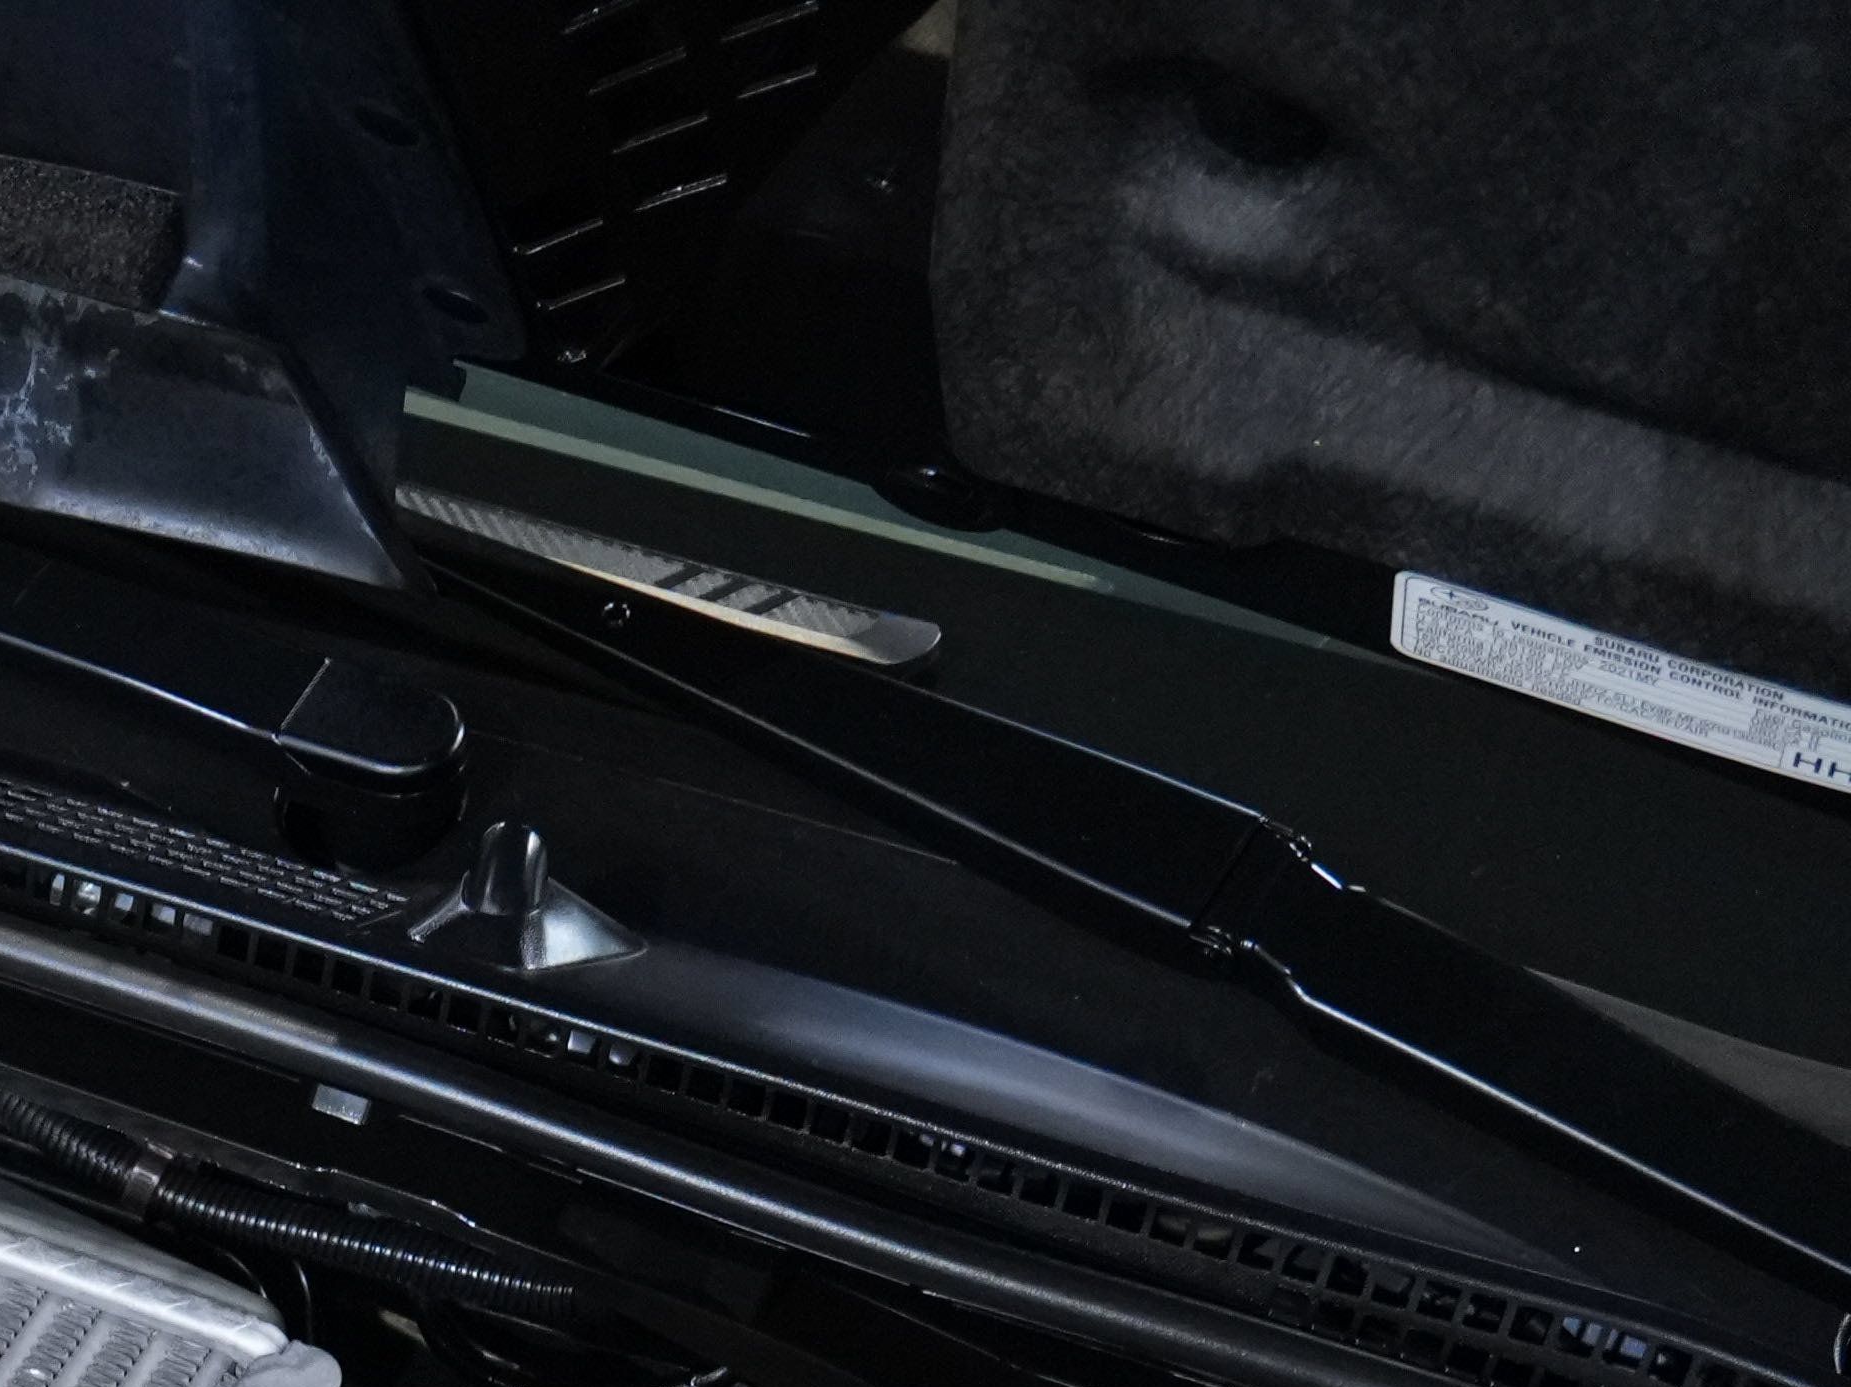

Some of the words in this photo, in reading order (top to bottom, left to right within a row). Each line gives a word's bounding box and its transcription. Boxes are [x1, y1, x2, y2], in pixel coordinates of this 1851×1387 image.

[1510, 620, 1577, 647] VEHICLE
[1583, 644, 1662, 675] EMISSION
[1668, 672, 1744, 700] CONTROL
[1594, 636, 1660, 663] SUBARU
[1667, 659, 1785, 701] CORPORATION
